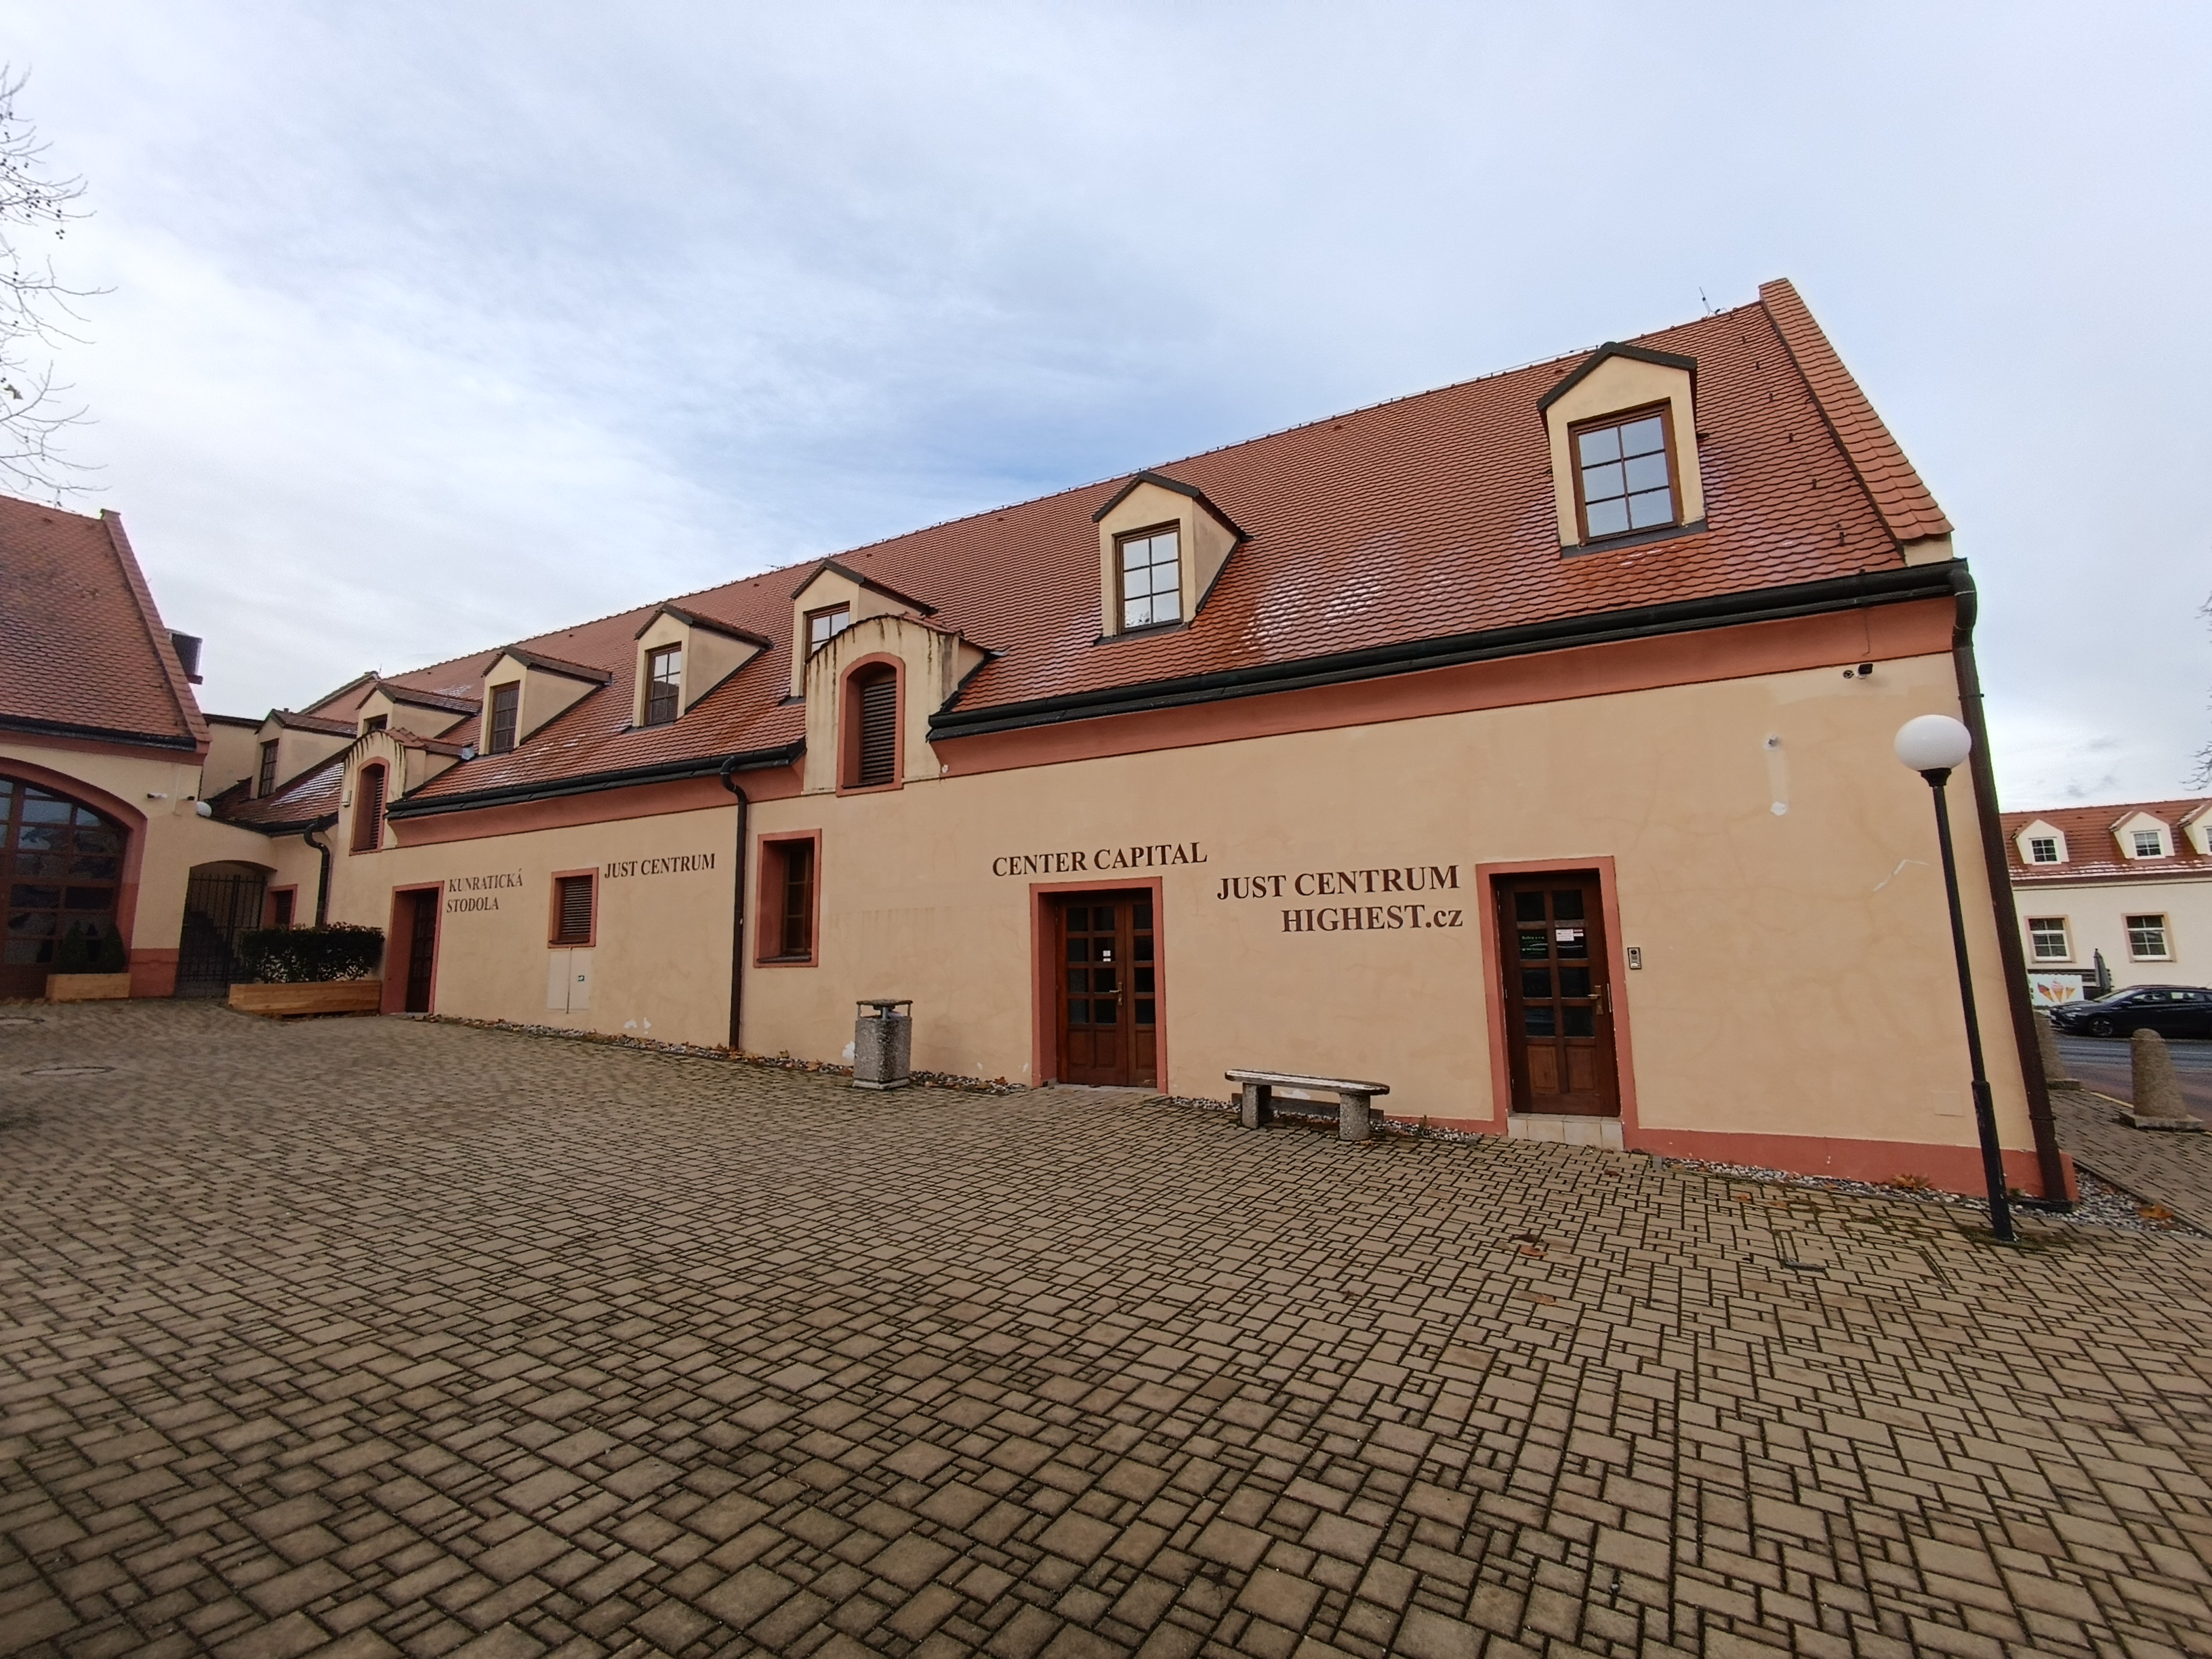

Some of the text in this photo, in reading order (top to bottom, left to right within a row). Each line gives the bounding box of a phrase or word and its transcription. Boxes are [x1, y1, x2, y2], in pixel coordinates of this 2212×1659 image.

[604, 853, 716, 879] JUST CENTRUM
[992, 841, 1208, 877] CENTER CAPITAL
[449, 867, 523, 893] KUNRATICKÁ
[1216, 864, 1460, 901] JUST CENTRUM
[446, 897, 499, 914] STODOLA
[1280, 904, 1463, 933] HIGHEST.cz
